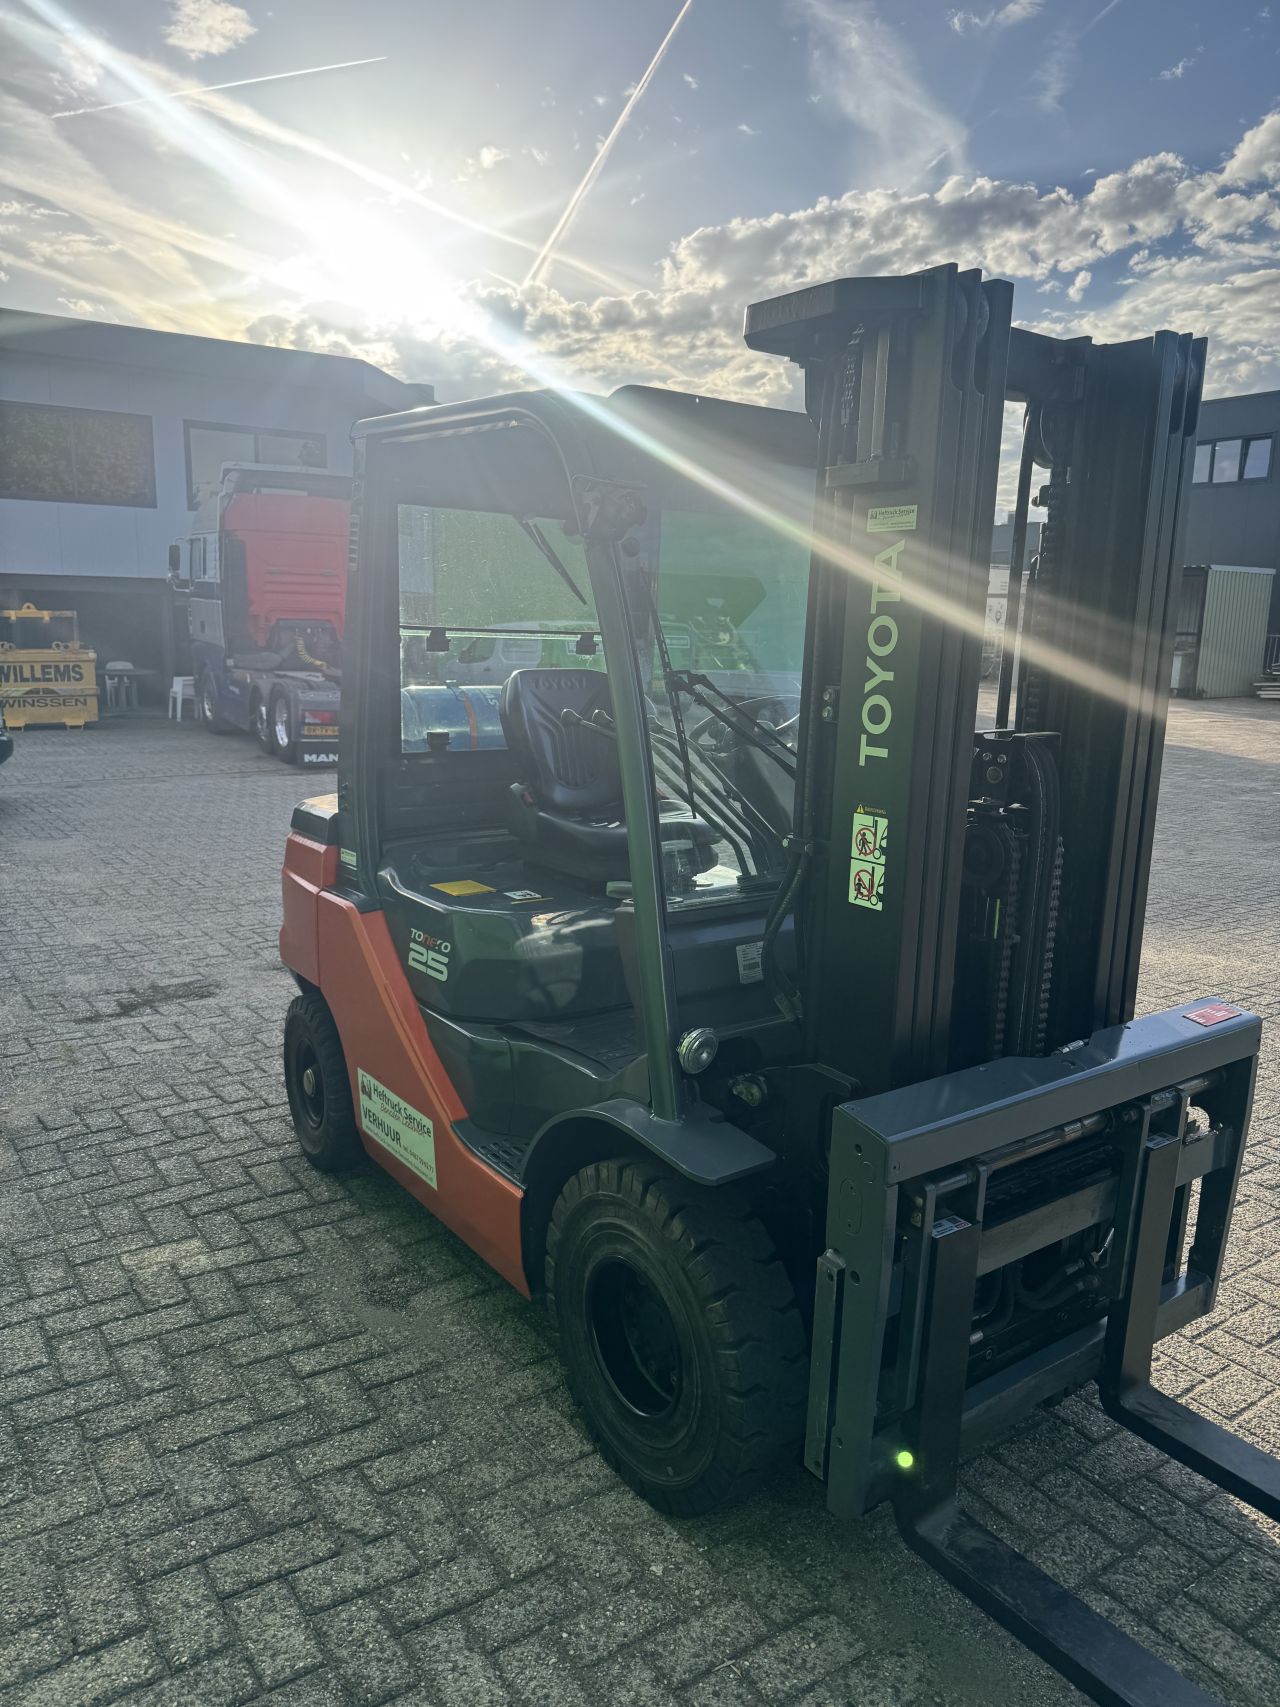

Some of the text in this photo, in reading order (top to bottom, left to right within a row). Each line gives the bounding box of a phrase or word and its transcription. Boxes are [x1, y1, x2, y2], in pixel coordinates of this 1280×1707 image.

[858, 538, 906, 767] TOYOTA
[0, 663, 84, 683] WILLEMS
[3, 697, 88, 709] WINSSEN
[303, 753, 339, 763] MAN
[408, 942, 449, 982] 25
[362, 1104, 402, 1147] VERHUUR
[373, 1083, 432, 1138] Heftruck Service
